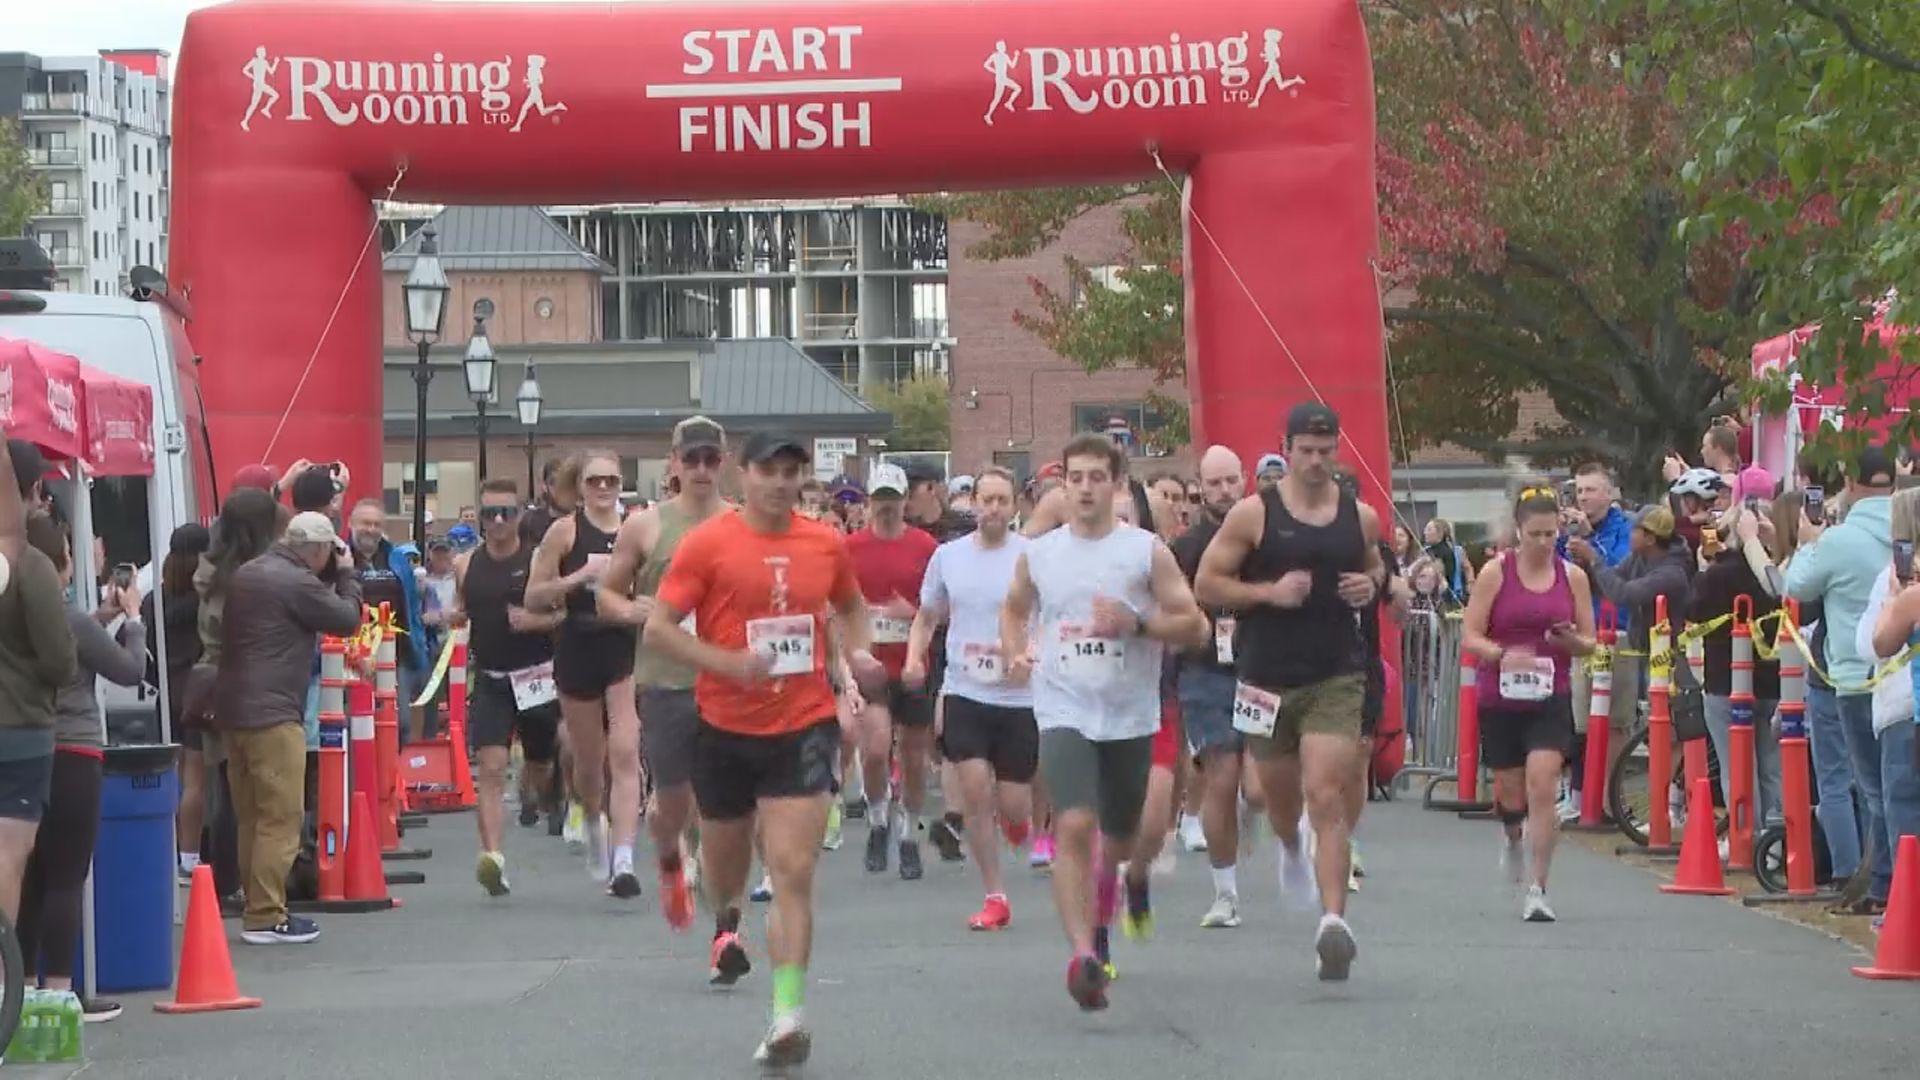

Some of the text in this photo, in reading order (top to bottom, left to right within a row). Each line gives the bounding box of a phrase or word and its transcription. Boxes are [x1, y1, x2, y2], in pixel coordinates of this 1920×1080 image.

[682, 25, 863, 75] START
[1023, 31, 1249, 113] Running
[283, 52, 512, 126] Running
[679, 101, 872, 153] FINISH
[976, 656, 994, 670] 76
[1074, 641, 1106, 657] 144
